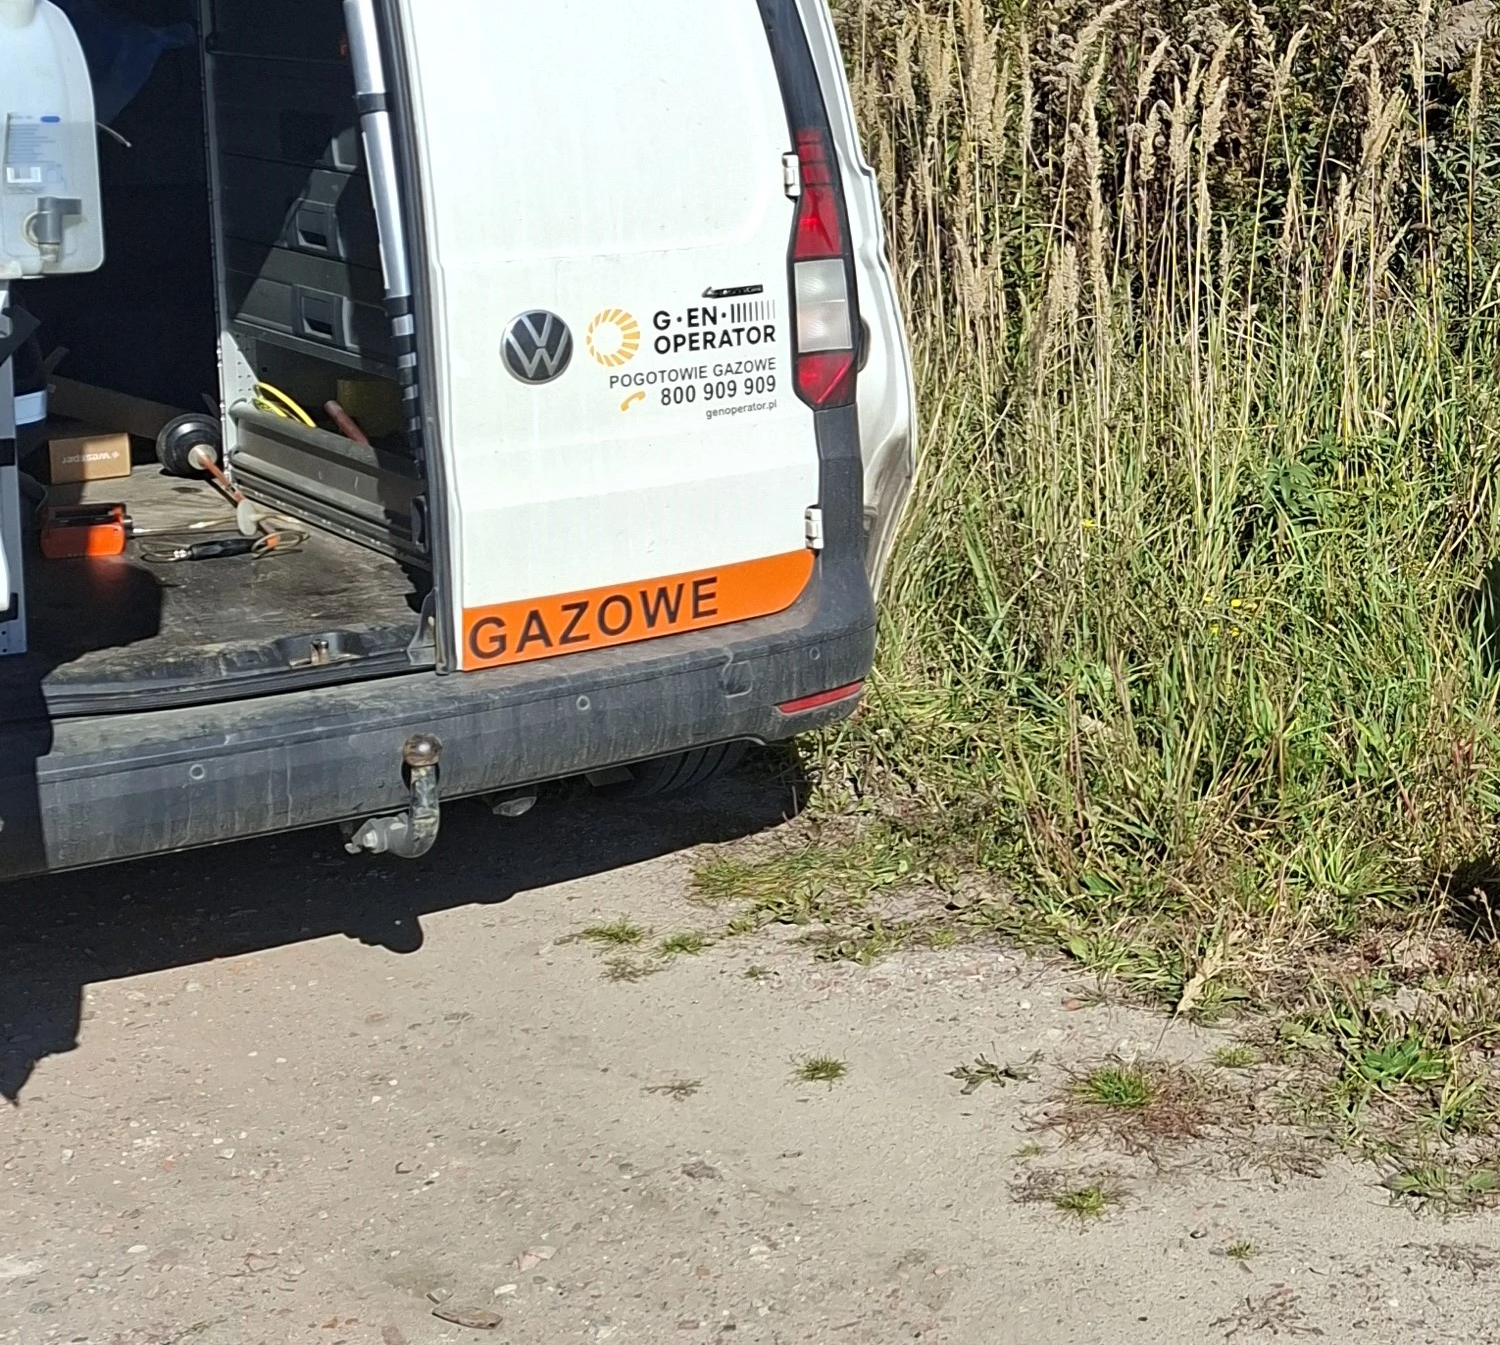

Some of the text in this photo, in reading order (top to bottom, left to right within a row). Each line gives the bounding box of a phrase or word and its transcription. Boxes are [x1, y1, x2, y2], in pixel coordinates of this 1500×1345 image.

[653, 324, 777, 355] OPERATOR
[609, 357, 777, 389] POGOTOWIE GAZOWE
[660, 374, 776, 406] 800 909 909
[705, 399, 778, 420] genoperator.pl
[468, 576, 718, 660] GAZOWE
